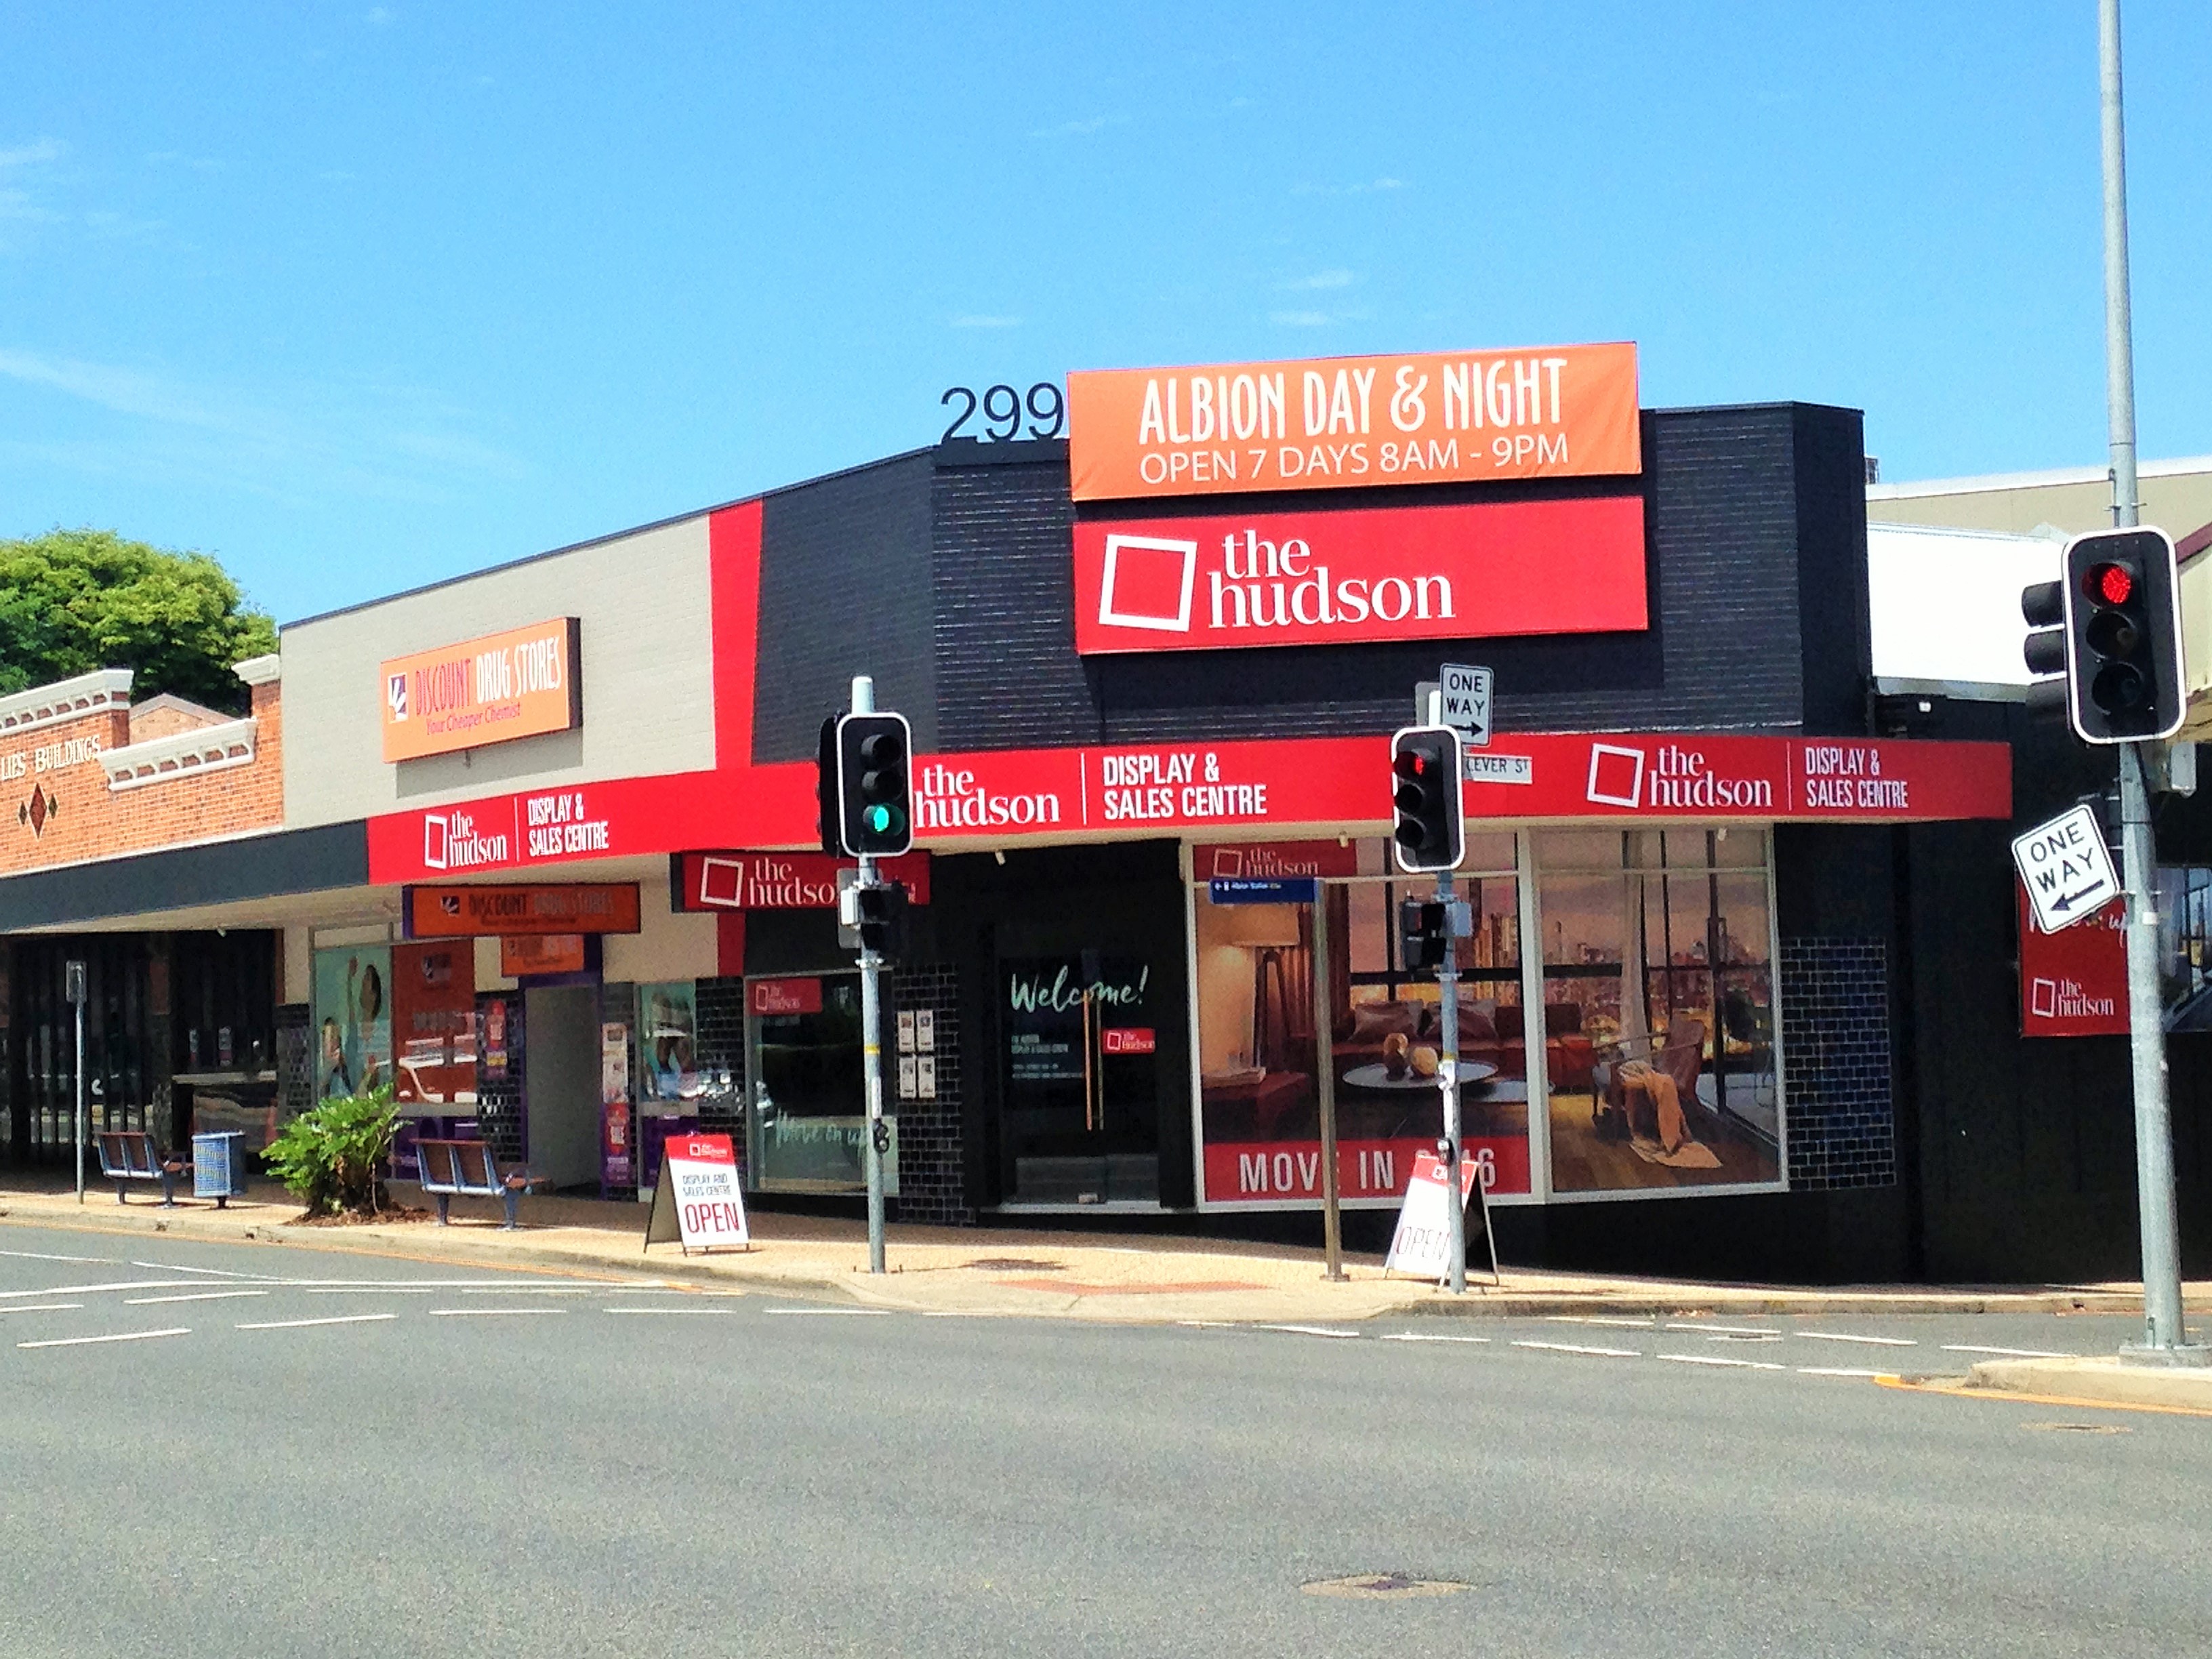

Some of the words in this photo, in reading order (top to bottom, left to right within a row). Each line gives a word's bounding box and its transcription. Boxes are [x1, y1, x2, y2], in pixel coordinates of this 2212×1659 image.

[941, 382, 1064, 441] 299
[1139, 373, 1286, 445] ALBION
[1303, 367, 1376, 436] DAY
[1390, 365, 1428, 432] &
[1443, 358, 1568, 430] NIGHT
[1140, 449, 1236, 484] OPEN
[1248, 449, 1267, 478] 7
[1279, 443, 1369, 478] DAYS
[1380, 438, 1459, 472] 8AM
[1492, 433, 1568, 466] 9PM
[1221, 529, 1311, 579] the
[1206, 567, 1456, 628] hudson
[415, 658, 471, 716] DISCOUNT
[476, 648, 510, 703] DRUG
[514, 636, 562, 698] STORES
[1450, 673, 1483, 693] ONE
[426, 718, 445, 735] Your
[447, 713, 483, 731] Cheaper
[485, 702, 520, 723] Chemist
[1446, 697, 1485, 716] WAY
[35, 735, 101, 773] BUILDINGS
[1103, 754, 1195, 786] DISPLAY
[1205, 753, 1219, 783] &
[1658, 745, 1704, 777] the
[1805, 747, 1865, 775] DISPLAY
[1870, 749, 1880, 775] &
[922, 764, 974, 797] the
[1650, 771, 1772, 807] hudson
[1807, 779, 1853, 807] SALES
[1858, 780, 1908, 808] CENTRE
[527, 794, 572, 826] DISPLAY
[575, 793, 584, 820] &
[914, 790, 1060, 828] hudson
[1104, 787, 1174, 821] SALES
[1181, 785, 1267, 817] CENTRE
[450, 811, 473, 839] the
[529, 826, 562, 857] SALES
[565, 821, 609, 852] CENTRE
[2030, 821, 2085, 863] ONE
[449, 831, 508, 867] hudson
[1250, 848, 1276, 863] the
[755, 857, 793, 882] the
[1246, 859, 1319, 877] hudson
[2035, 847, 2093, 893] WAY
[749, 877, 836, 907] hudso
[1010, 964, 1149, 1014] Welcome!
[2057, 993, 2114, 1017] hudson
[2060, 979, 2082, 997] the
[1240, 1151, 1340, 1193] MOV
[1359, 1151, 1394, 1190] IN
[684, 1202, 740, 1233] OPEN
[1396, 1226, 1452, 1261] OPEN
